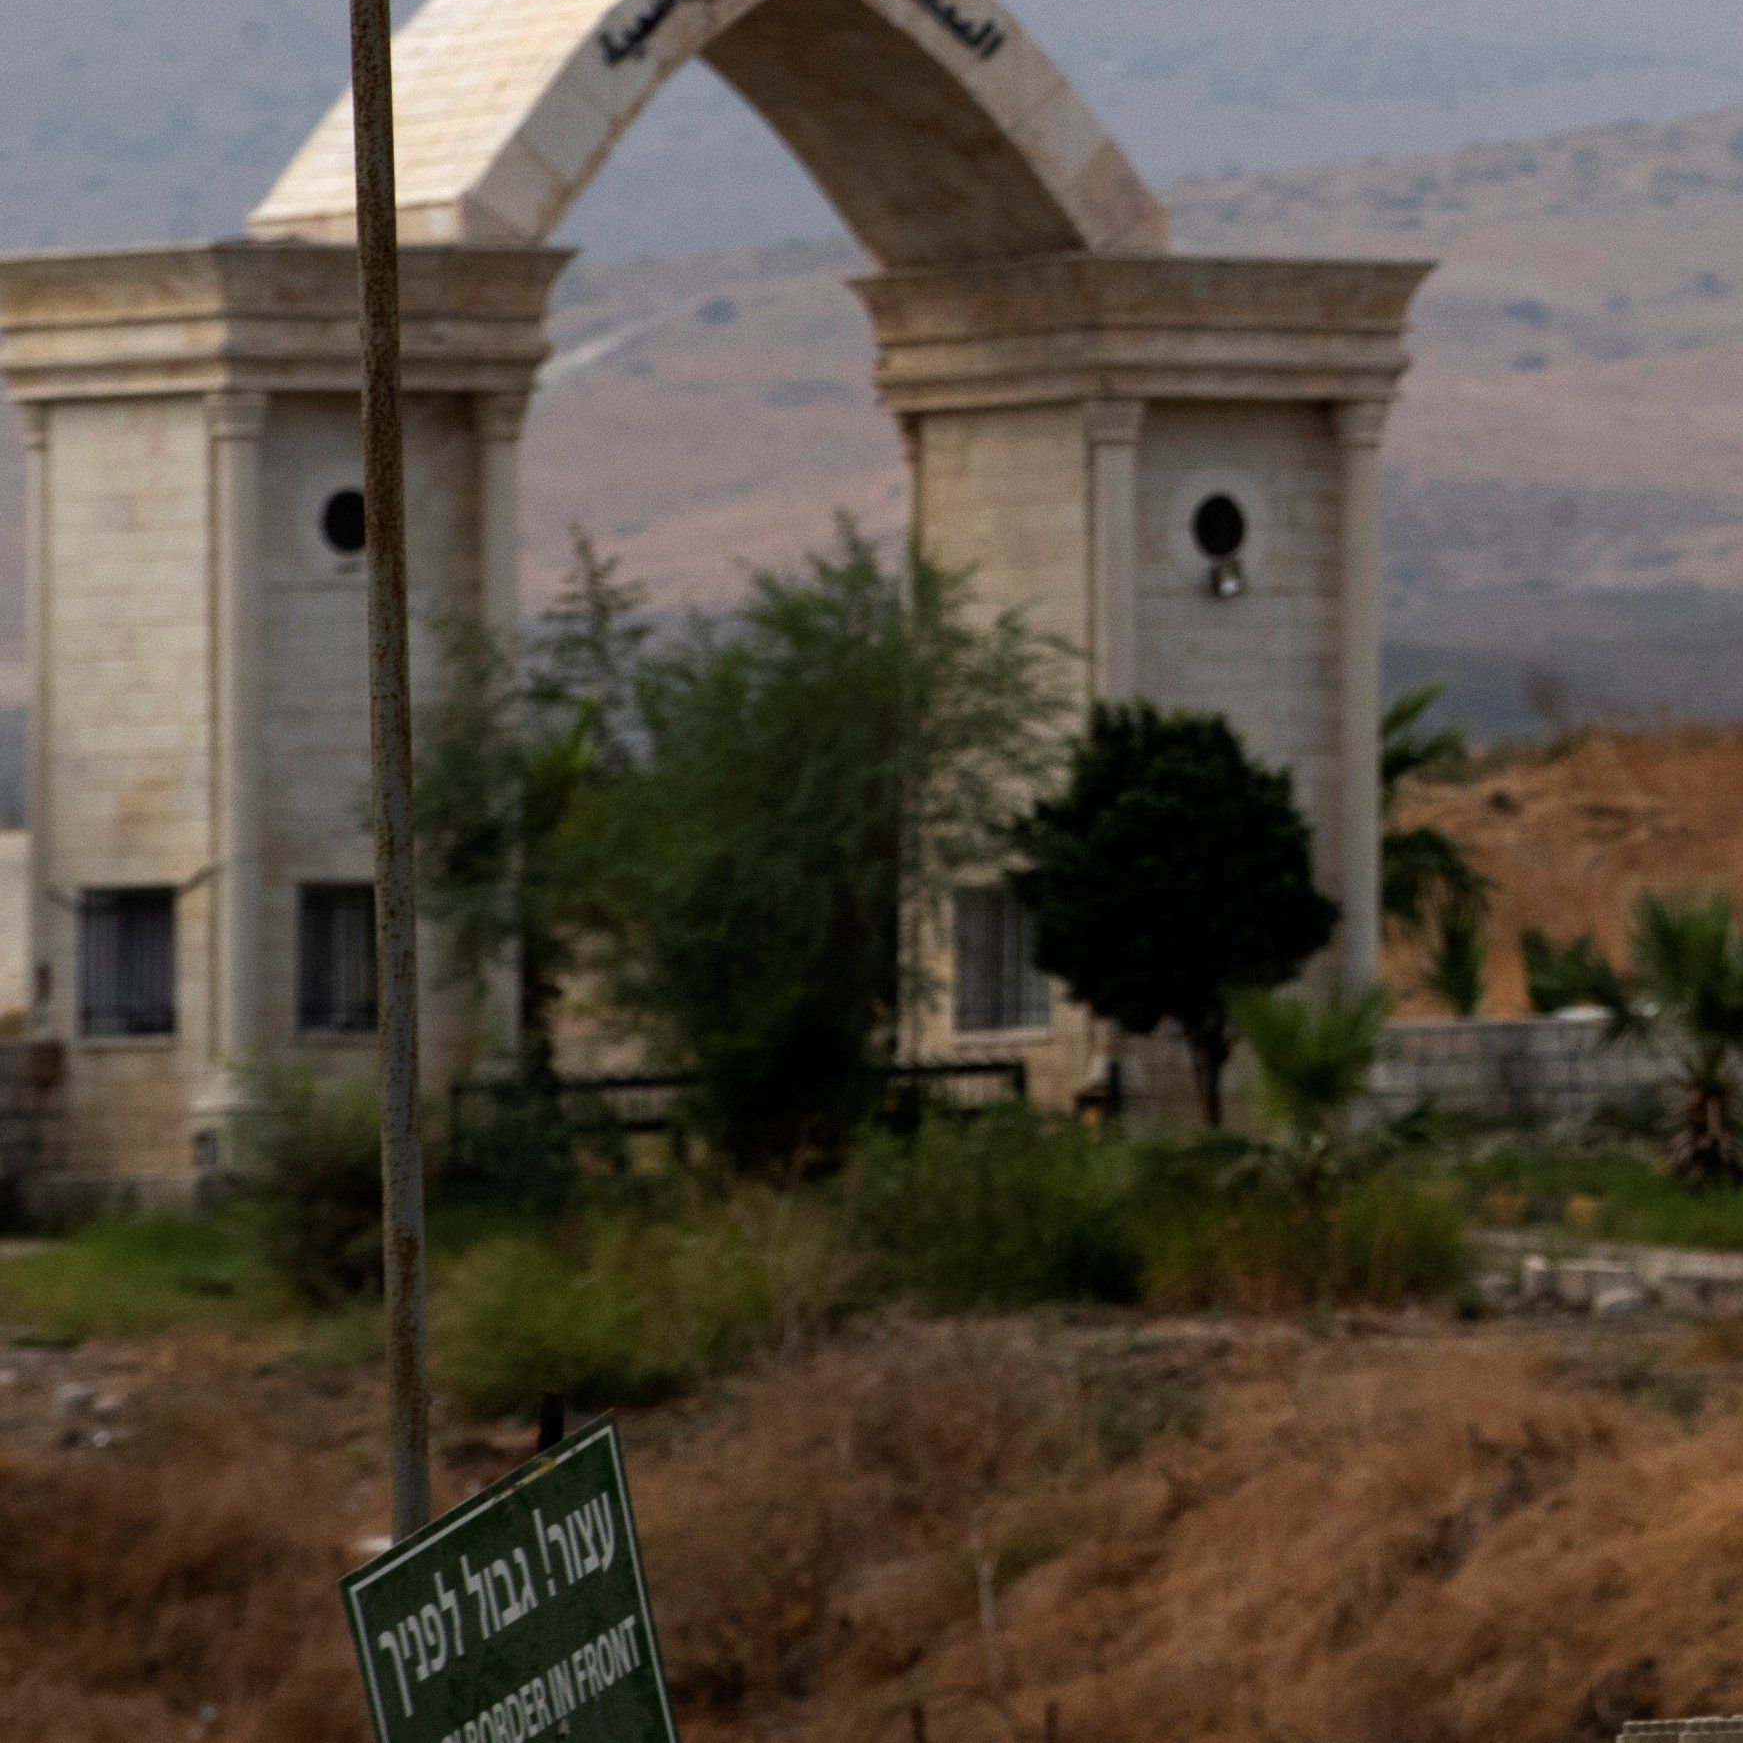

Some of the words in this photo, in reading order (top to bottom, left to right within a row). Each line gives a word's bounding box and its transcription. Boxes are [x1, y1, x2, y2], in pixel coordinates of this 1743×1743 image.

[460, 1547, 538, 1640] גבול
[532, 1491, 616, 1598] עצור!
[377, 1570, 465, 1717] לפניך
[546, 1659, 577, 1720] IN
[571, 1614, 641, 1704] FRONT
